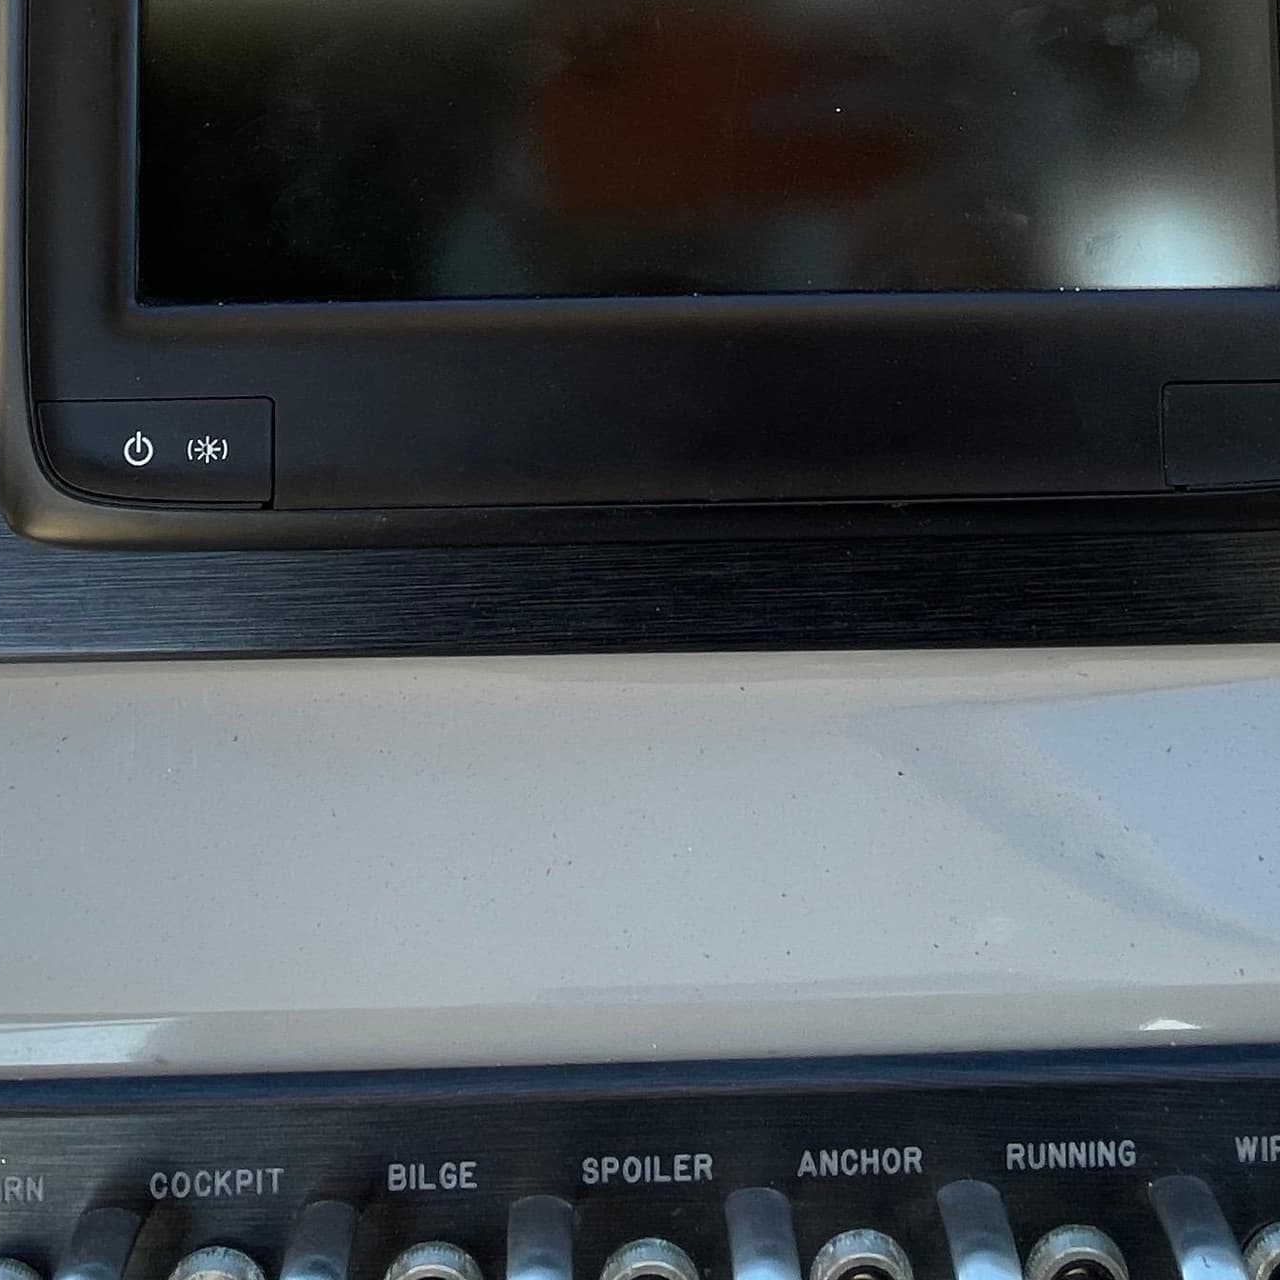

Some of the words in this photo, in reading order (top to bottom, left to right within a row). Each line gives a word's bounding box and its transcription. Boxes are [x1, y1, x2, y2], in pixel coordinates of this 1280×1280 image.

[581, 1153, 714, 1185] SPOILER
[797, 1146, 923, 1177] ANCHOR
[1006, 1140, 1137, 1170] RUNNING
[149, 1167, 285, 1201] COCKPIT
[387, 1161, 478, 1193] BILGE
